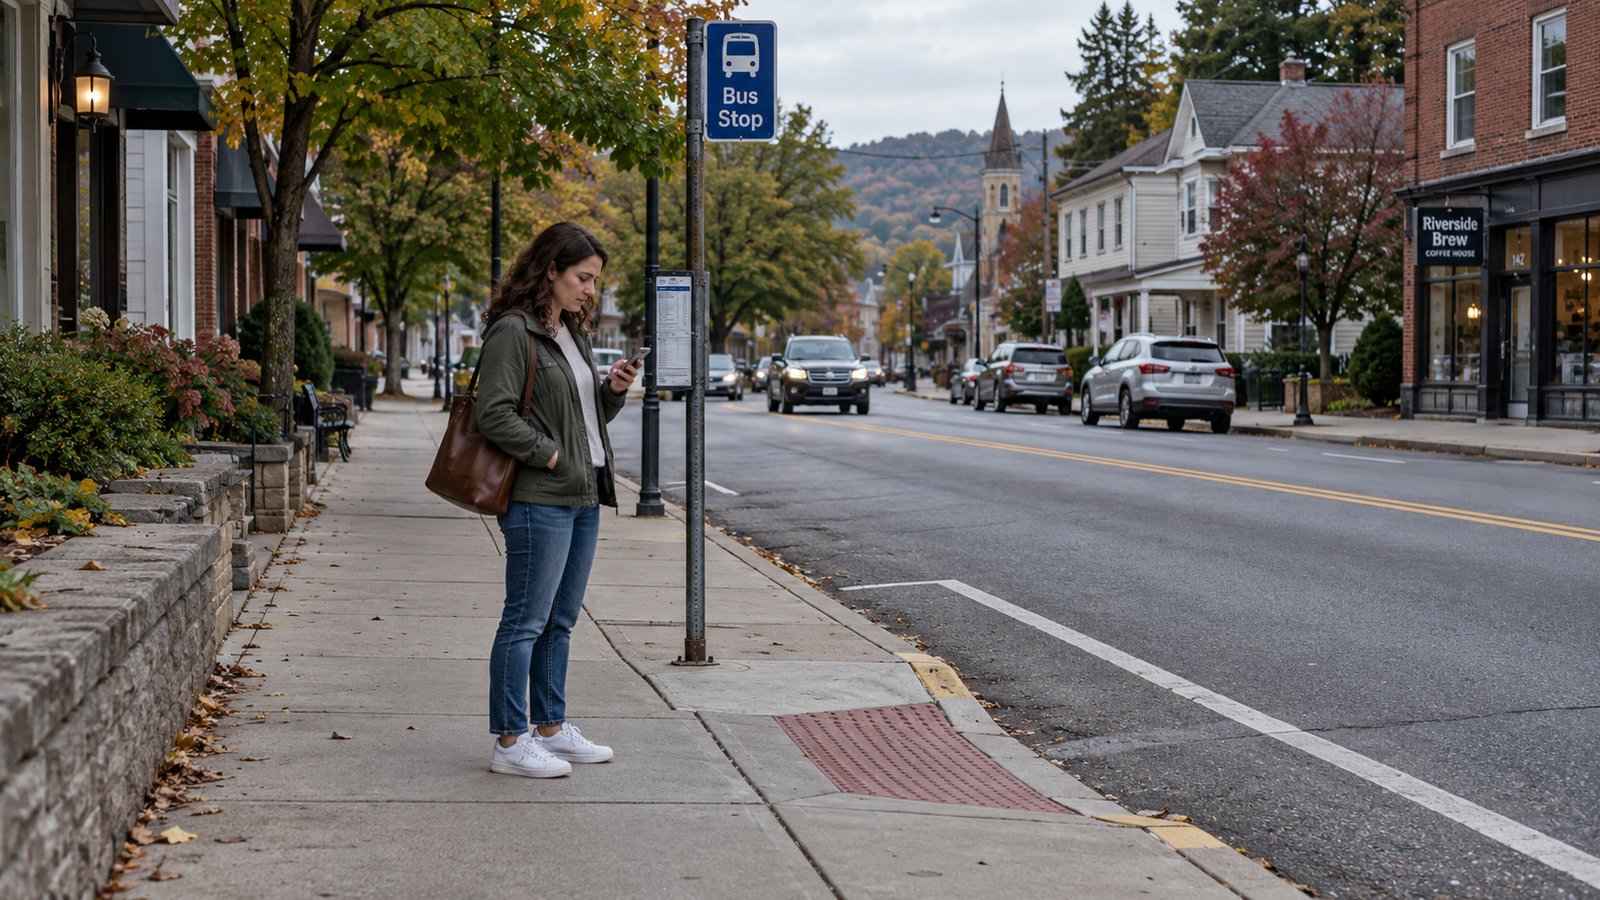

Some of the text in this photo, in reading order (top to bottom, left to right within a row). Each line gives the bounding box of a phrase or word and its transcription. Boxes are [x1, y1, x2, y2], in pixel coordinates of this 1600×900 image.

[723, 87, 758, 104] Bus
[718, 109, 763, 131] Stop
[1423, 216, 1478, 230] Riverside
[1432, 231, 1468, 246] Brew
